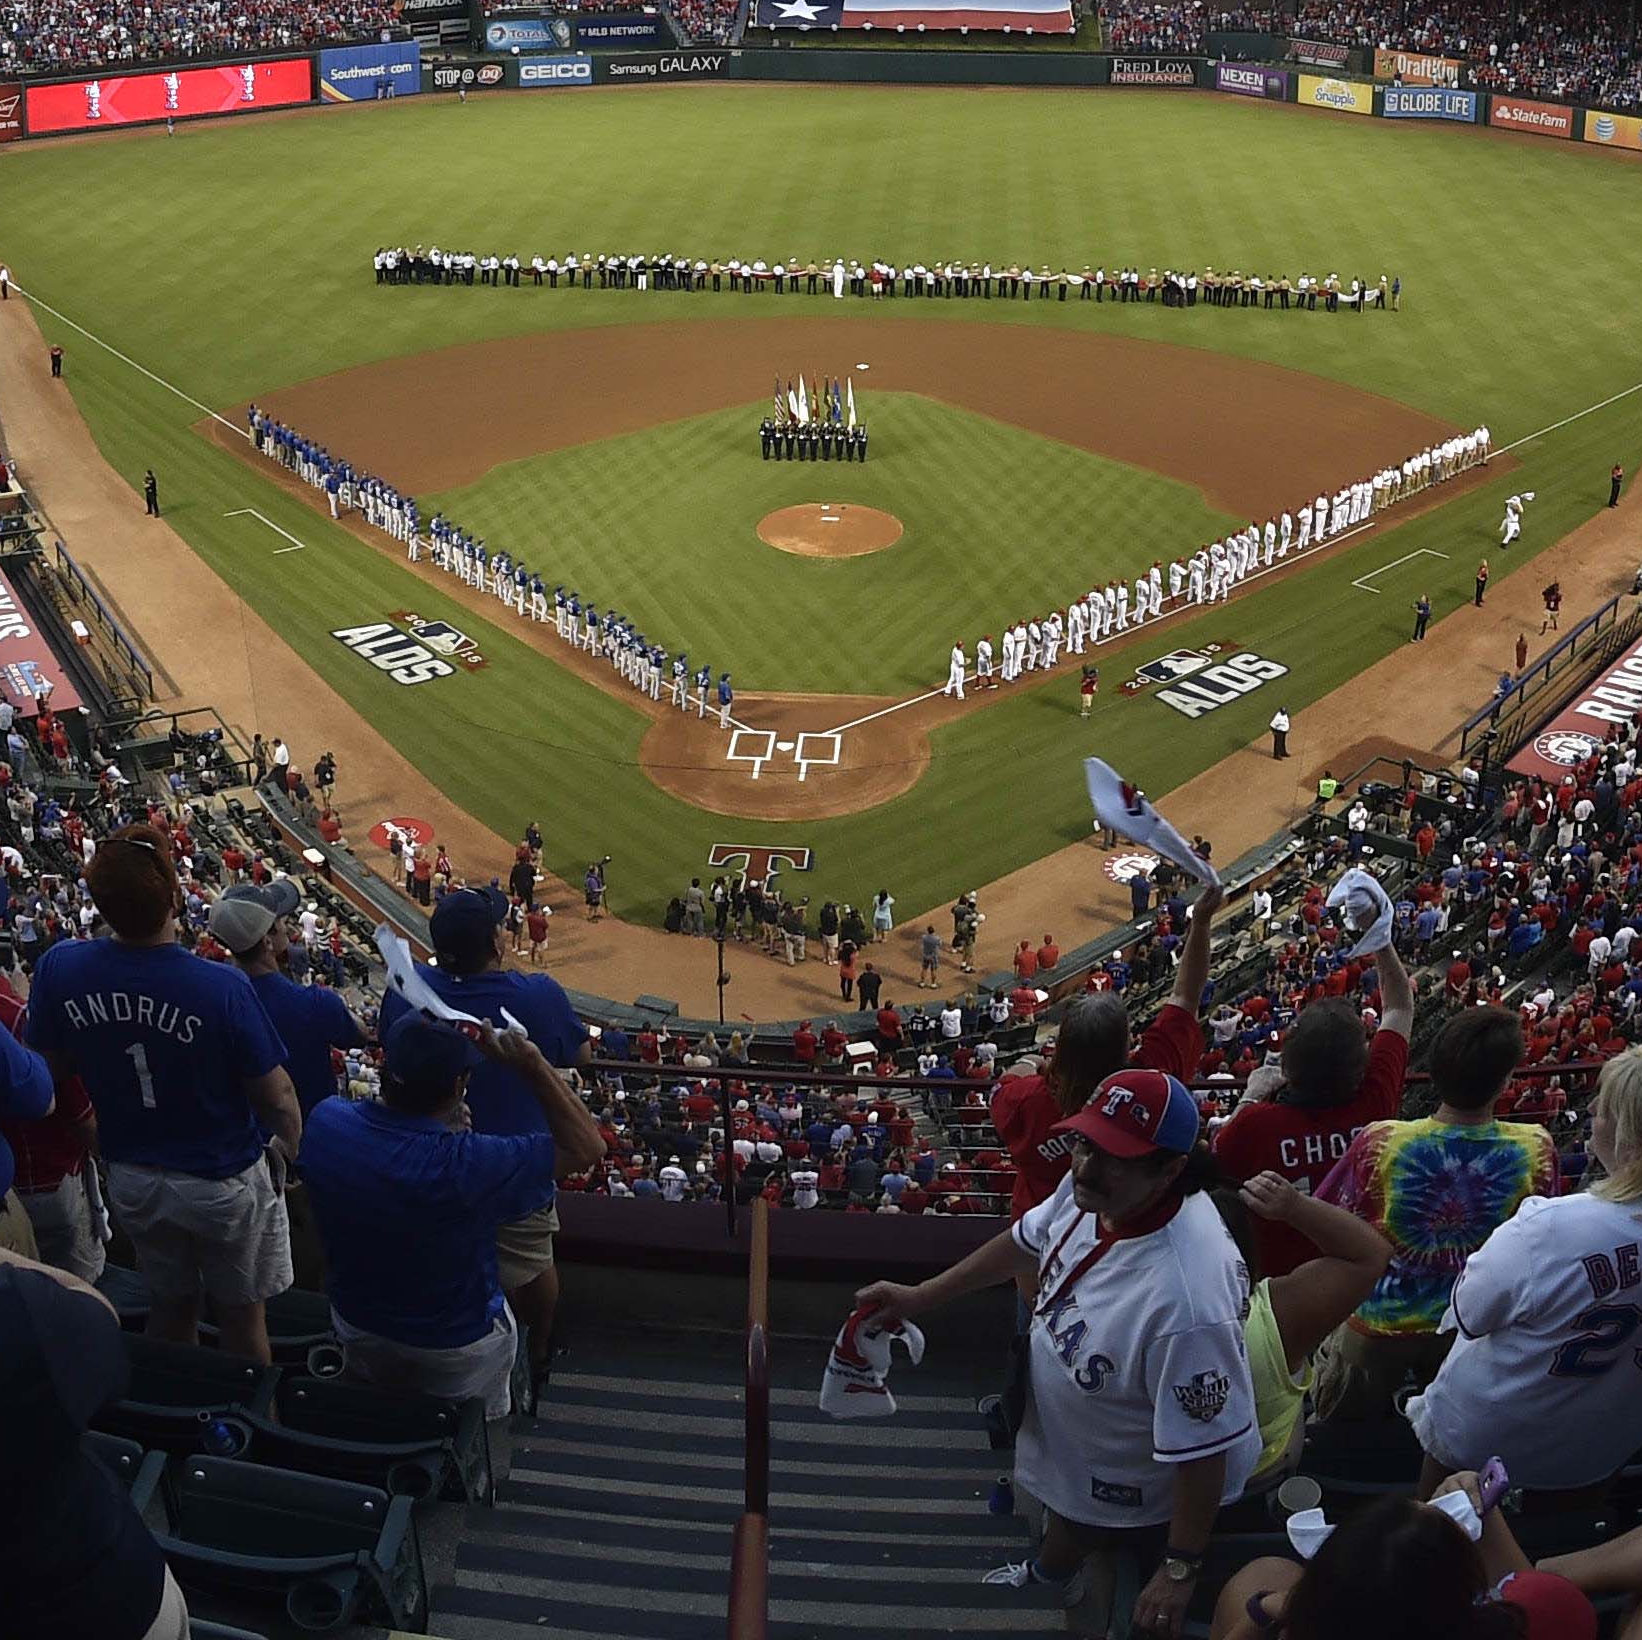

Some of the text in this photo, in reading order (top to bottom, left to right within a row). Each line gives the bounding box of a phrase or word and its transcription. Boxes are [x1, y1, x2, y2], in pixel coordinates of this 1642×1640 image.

[508, 28, 553, 41] TOTAL
[587, 24, 656, 37] MLB NETWORK
[435, 69, 498, 85] STOP @ DQ
[520, 64, 591, 79] GEICO
[610, 63, 656, 75] Samsung
[1111, 73, 1193, 83] INSURANCE
[1220, 67, 1264, 86] NEXEN
[1315, 88, 1355, 107] Snapple
[1400, 93, 1469, 116] GLOBE LIFE
[331, 623, 454, 684] ALDS
[1199, 643, 1222, 656] 15
[1125, 677, 1150, 689] 20
[1156, 653, 1289, 719] ALDS
[708, 844, 809, 893] T
[63, 991, 203, 1044] ANDRUS
[124, 1042, 157, 1108] 1
[1102, 1085, 1134, 1116] T
[1172, 1375, 1232, 1400] WORLD
[1183, 1390, 1228, 1411] SERIES
